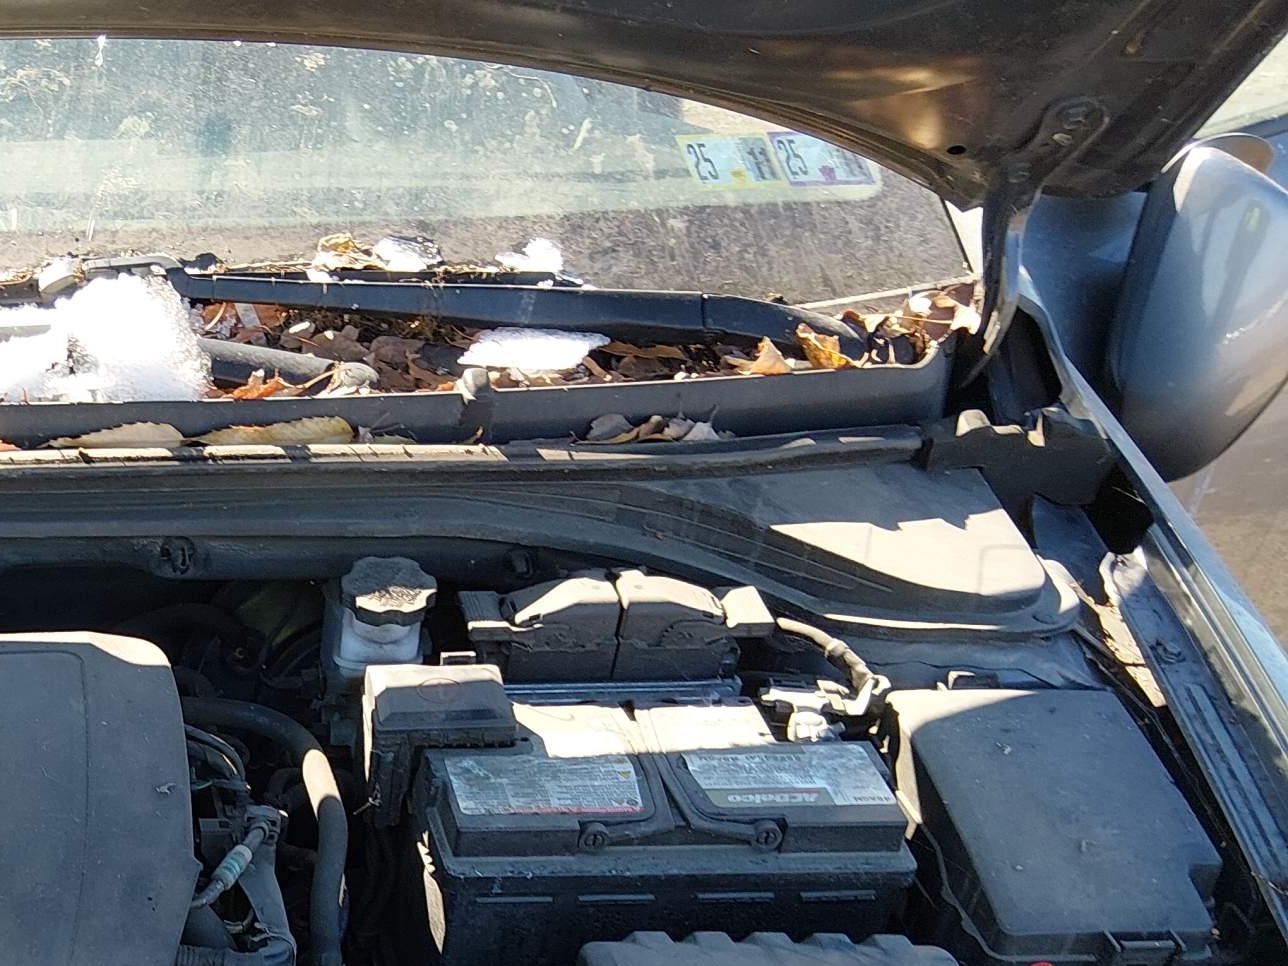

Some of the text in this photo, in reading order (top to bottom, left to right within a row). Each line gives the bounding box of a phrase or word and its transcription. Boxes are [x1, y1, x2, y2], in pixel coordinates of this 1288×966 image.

[686, 143, 720, 182] 25
[776, 139, 809, 177] 25
[727, 792, 819, 803] ACDelco
